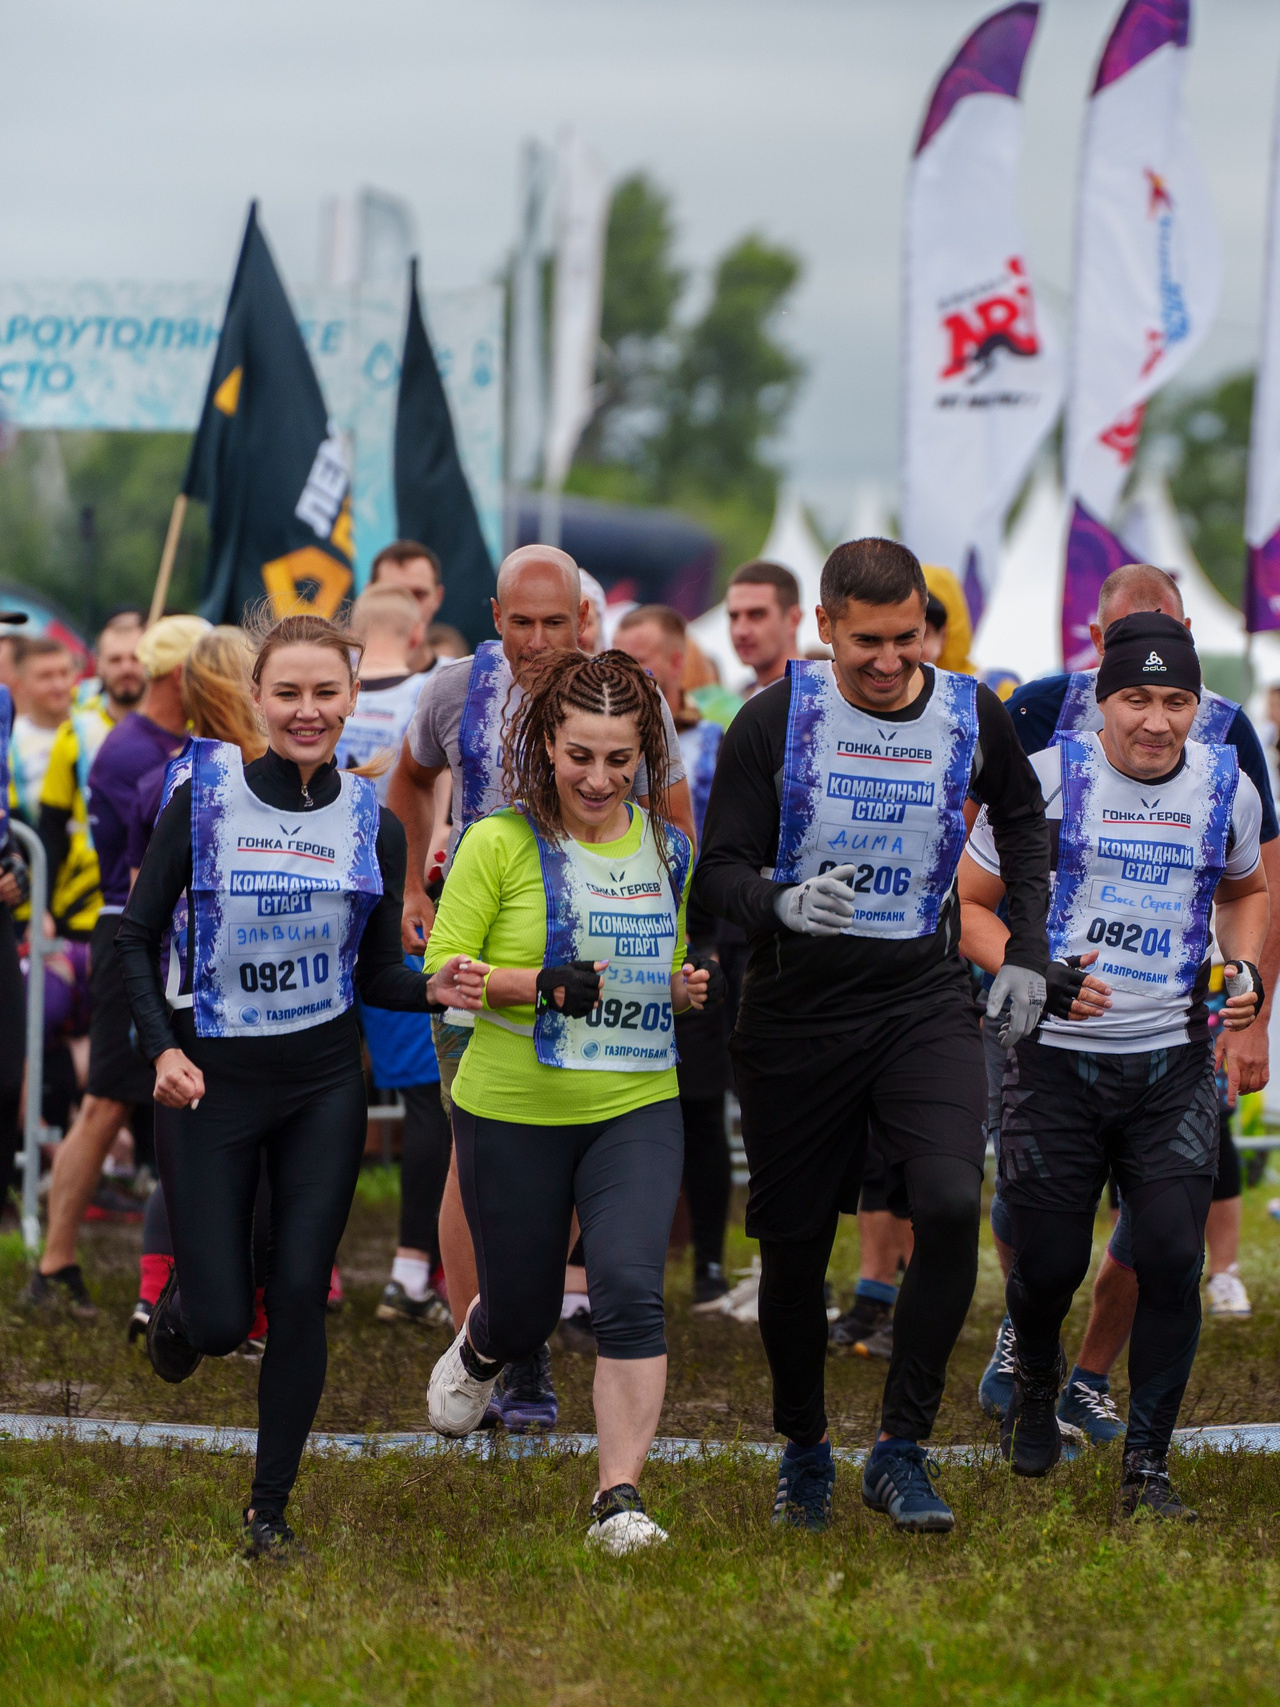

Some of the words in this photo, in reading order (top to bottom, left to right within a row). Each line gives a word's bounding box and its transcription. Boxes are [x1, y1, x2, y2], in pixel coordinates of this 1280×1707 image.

[837, 740, 881, 756] ГОНКА
[885, 746, 932, 760] ГЕРОЕВ
[829, 776, 933, 804] КОМАНДНЫЙ
[855, 801, 903, 821] СТАРТ
[1102, 808, 1146, 821] ГОНКА
[1149, 811, 1192, 824] ГЕРОЕВ
[237, 837, 283, 849] ГОНКА
[287, 840, 335, 859] ГЕРОЕВ
[827, 830, 903, 855] ДИМА
[1100, 840, 1192, 867] КОМАНДНЫЙ
[1125, 862, 1168, 883] СТАРТ
[232, 874, 339, 895] КОМАНДНЫЙ
[620, 882, 661, 896] ГЕРОЕВ
[260, 894, 308, 914] СТАРТ
[1101, 885, 1136, 907] Босс
[591, 912, 673, 936] КОМАНДНЫЙ
[852, 909, 905, 922] ПРОМБАНК
[237, 922, 330, 946] ЭЛЬВИНА
[1086, 917, 1172, 958] 09204
[618, 936, 655, 955] СТАРТ
[239, 952, 329, 993] 09210
[1102, 962, 1169, 984] ГАЗПРОМБАНК
[266, 999, 332, 1021] ГАЗПРОМБАНК
[586, 998, 672, 1032] 09205
[604, 1045, 668, 1059] ГАЗПРОМБАНК
